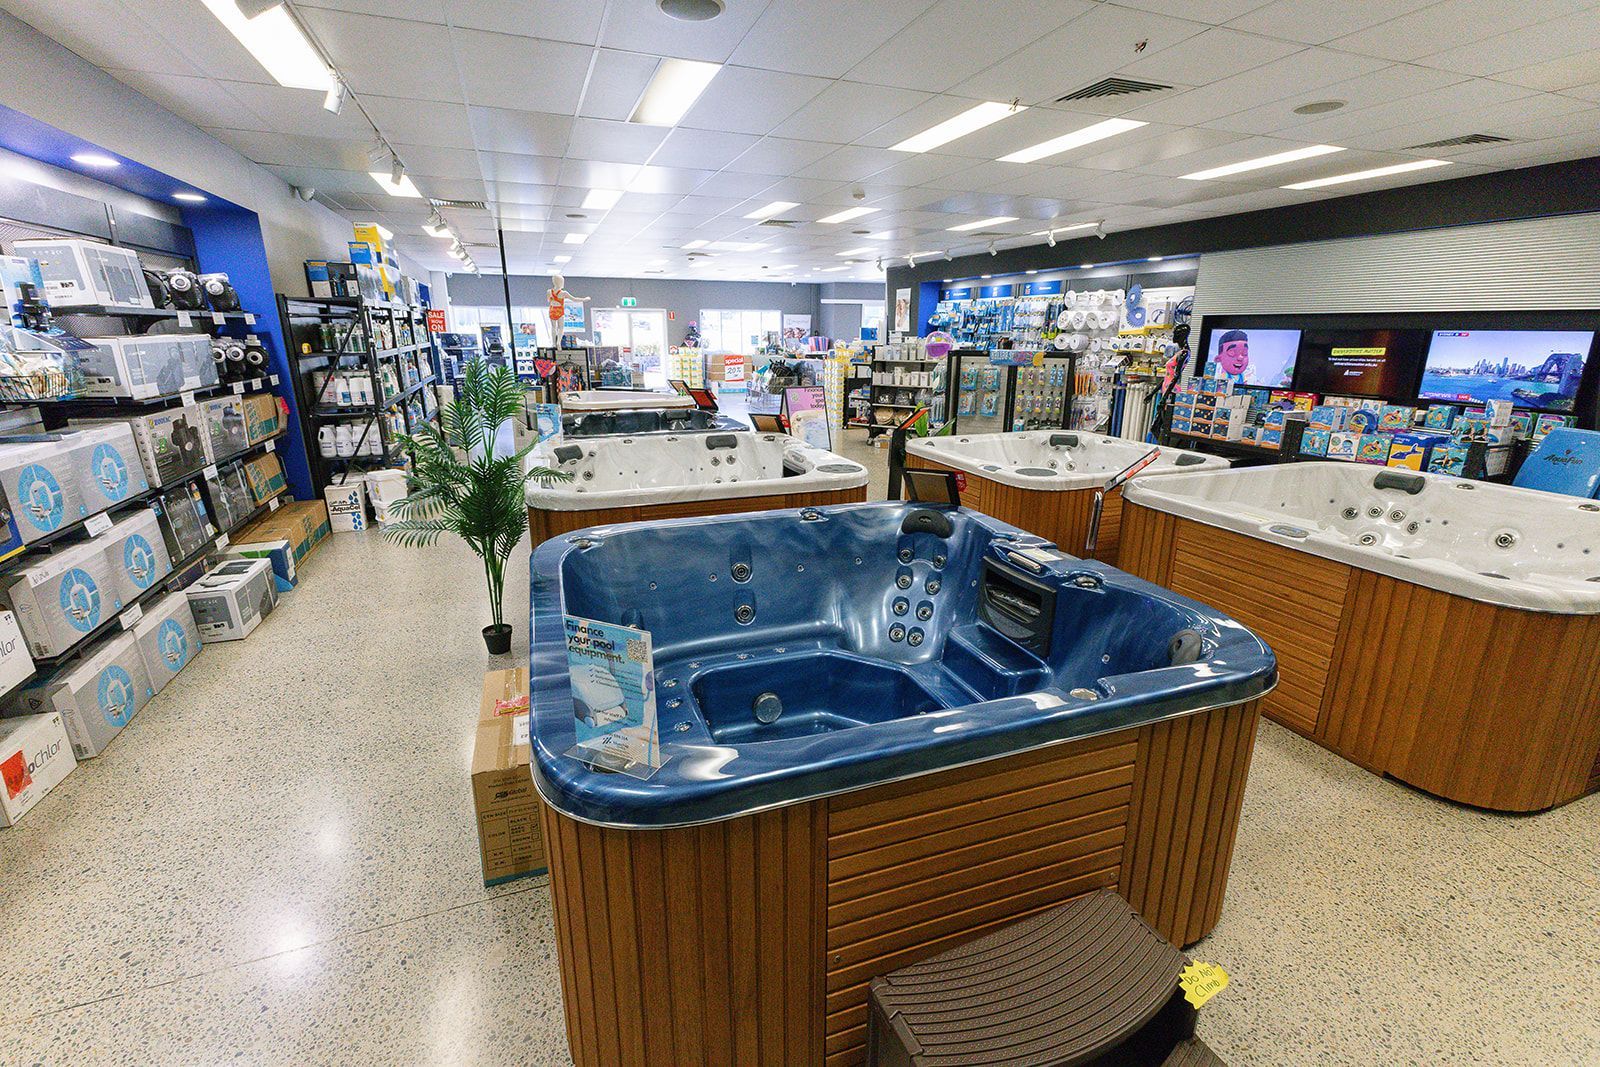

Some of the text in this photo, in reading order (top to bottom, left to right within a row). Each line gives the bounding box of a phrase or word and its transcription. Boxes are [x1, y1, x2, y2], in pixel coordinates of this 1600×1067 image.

[566, 620, 604, 638] Finance
[567, 634, 615, 651] your pool
[568, 644, 625, 664] equipment.
[28, 738, 62, 775] oChlor
[1184, 966, 1216, 985] Do Not
[1194, 978, 1221, 997] Climb
